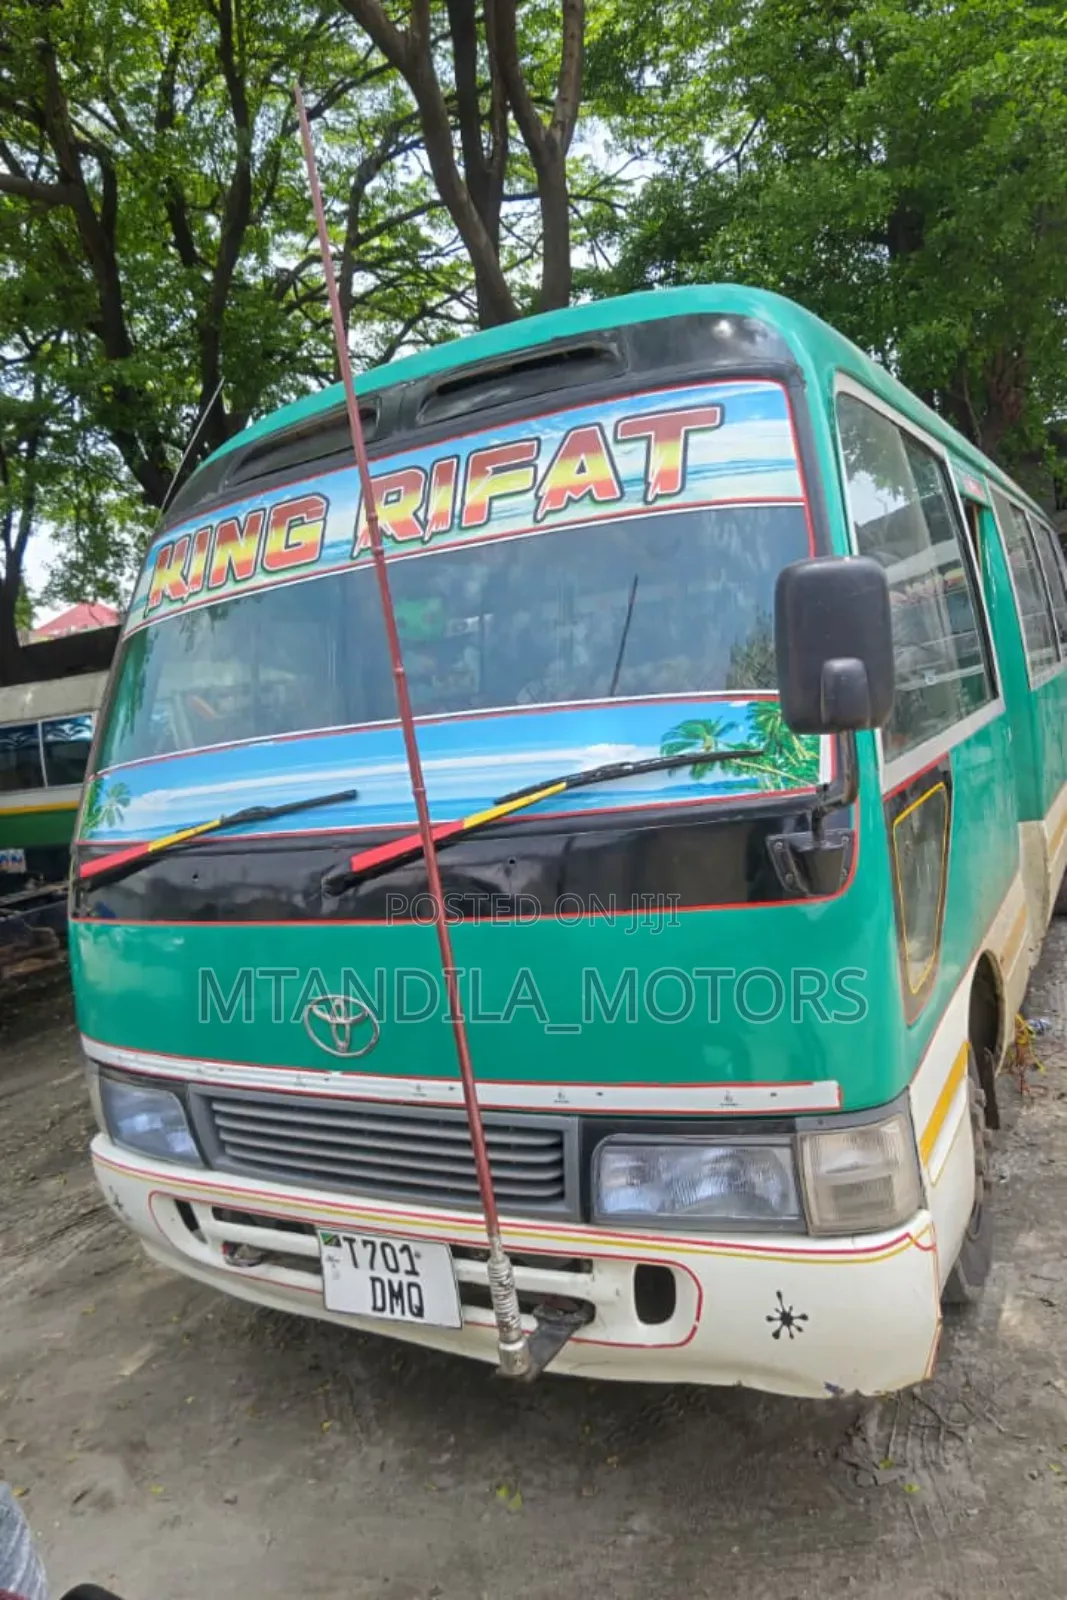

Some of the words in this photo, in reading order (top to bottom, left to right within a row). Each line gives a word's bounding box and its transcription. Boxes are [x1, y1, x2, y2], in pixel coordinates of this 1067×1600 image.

[147, 493, 328, 616] KING
[352, 405, 724, 558] RIFAT
[342, 1236, 420, 1277] T701
[369, 1275, 425, 1318] DMQ
